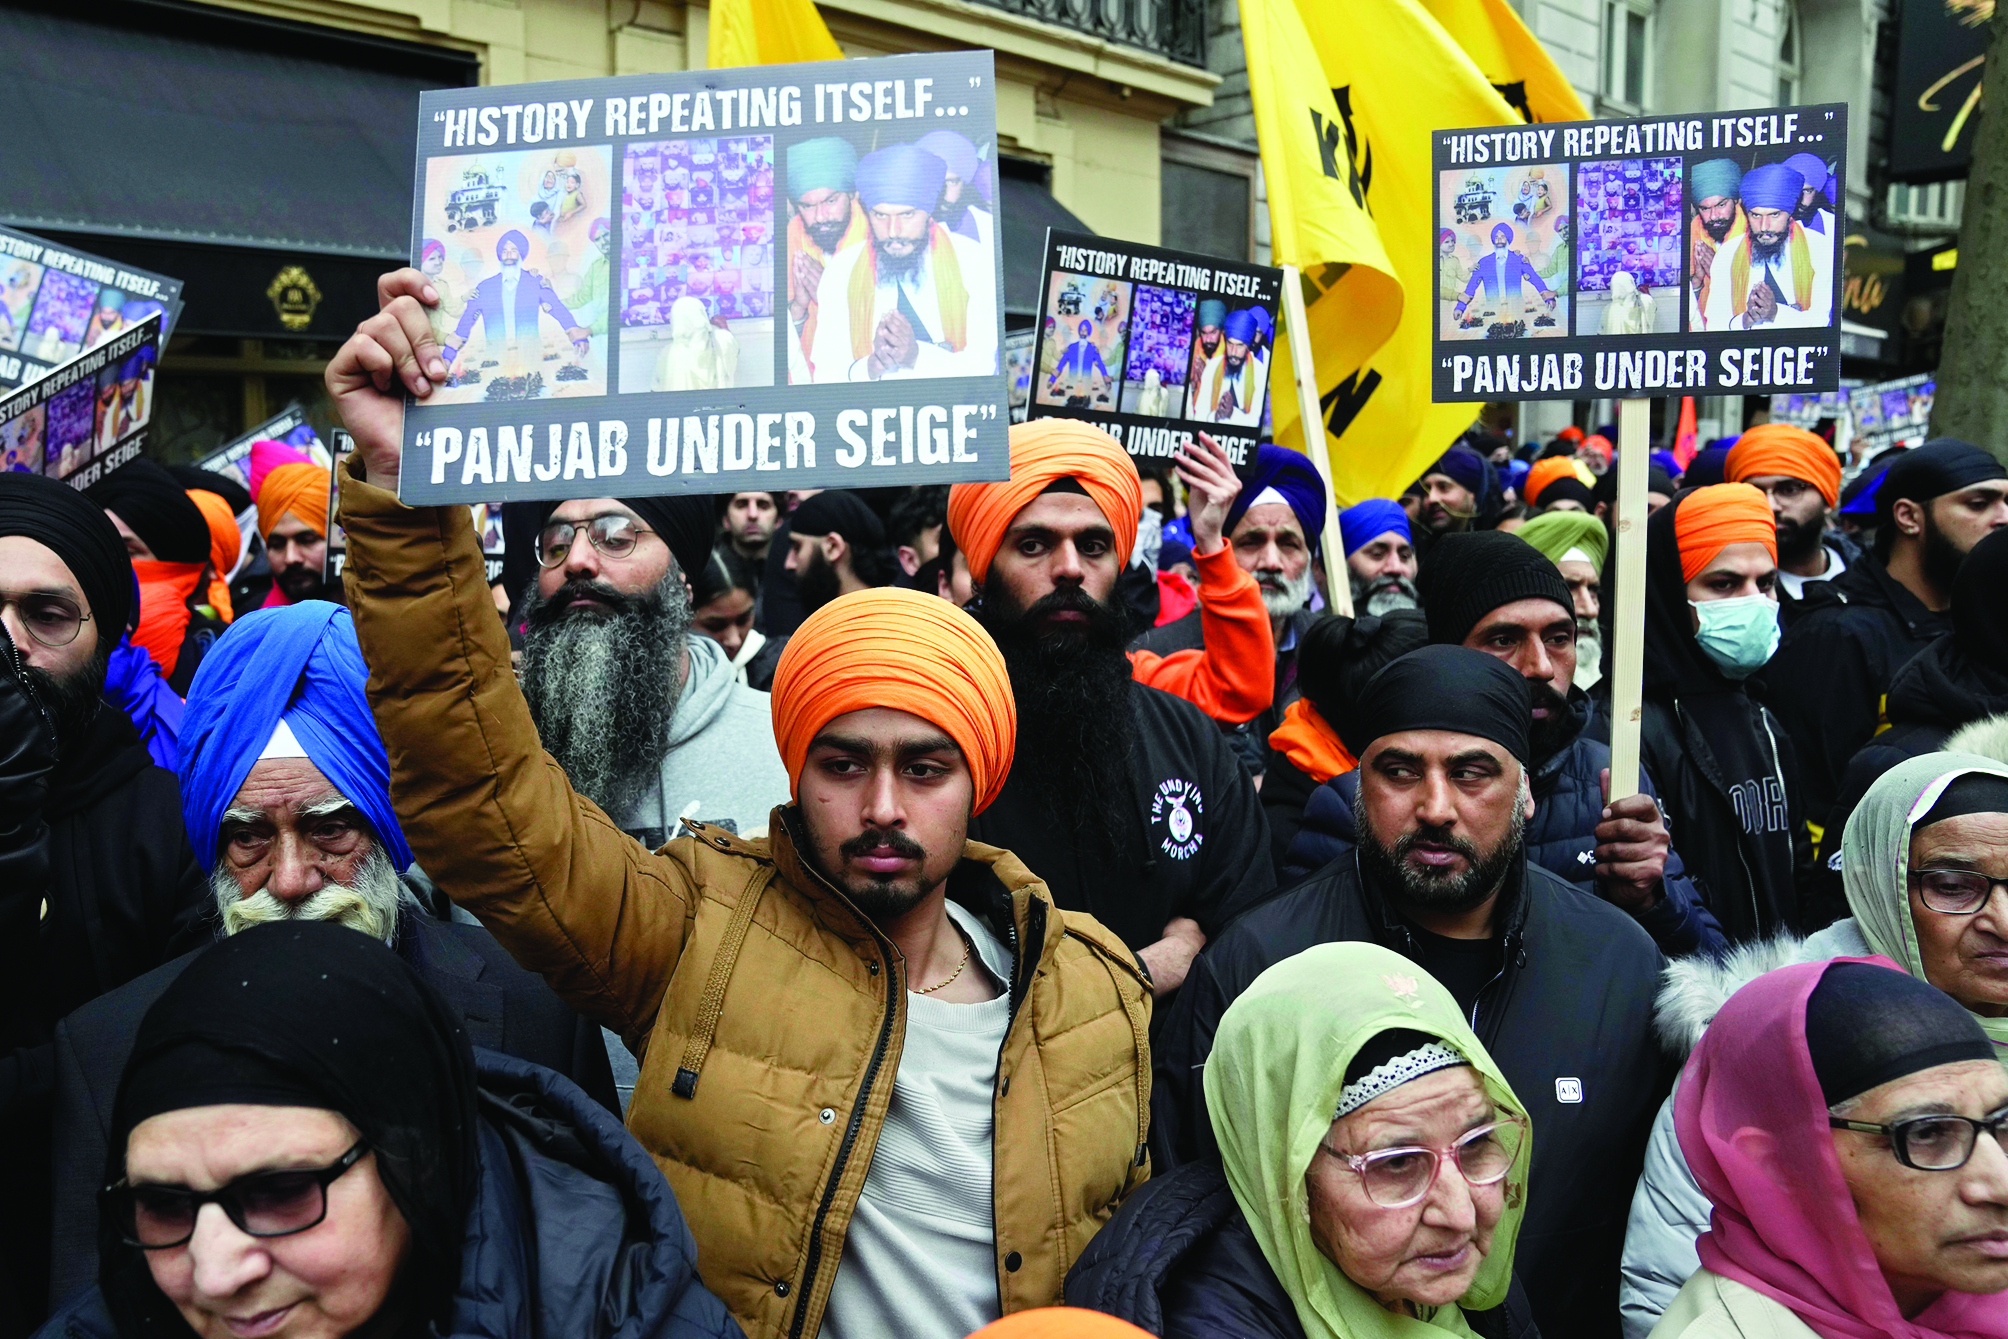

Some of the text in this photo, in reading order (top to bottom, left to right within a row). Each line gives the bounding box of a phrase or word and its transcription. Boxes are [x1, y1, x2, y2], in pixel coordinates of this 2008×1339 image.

[605, 86, 802, 137] REPEATING
[1564, 120, 1703, 157] REPEATING
[42, 249, 116, 285] REPEATING
[1130, 259, 1211, 291] REPEATING
[42, 350, 106, 399] REPEATING
[1595, 349, 1706, 390] UNDER
[646, 413, 815, 474] UNDER
[1151, 792, 1164, 824] THE
[1161, 833, 1203, 860] MORCHA
